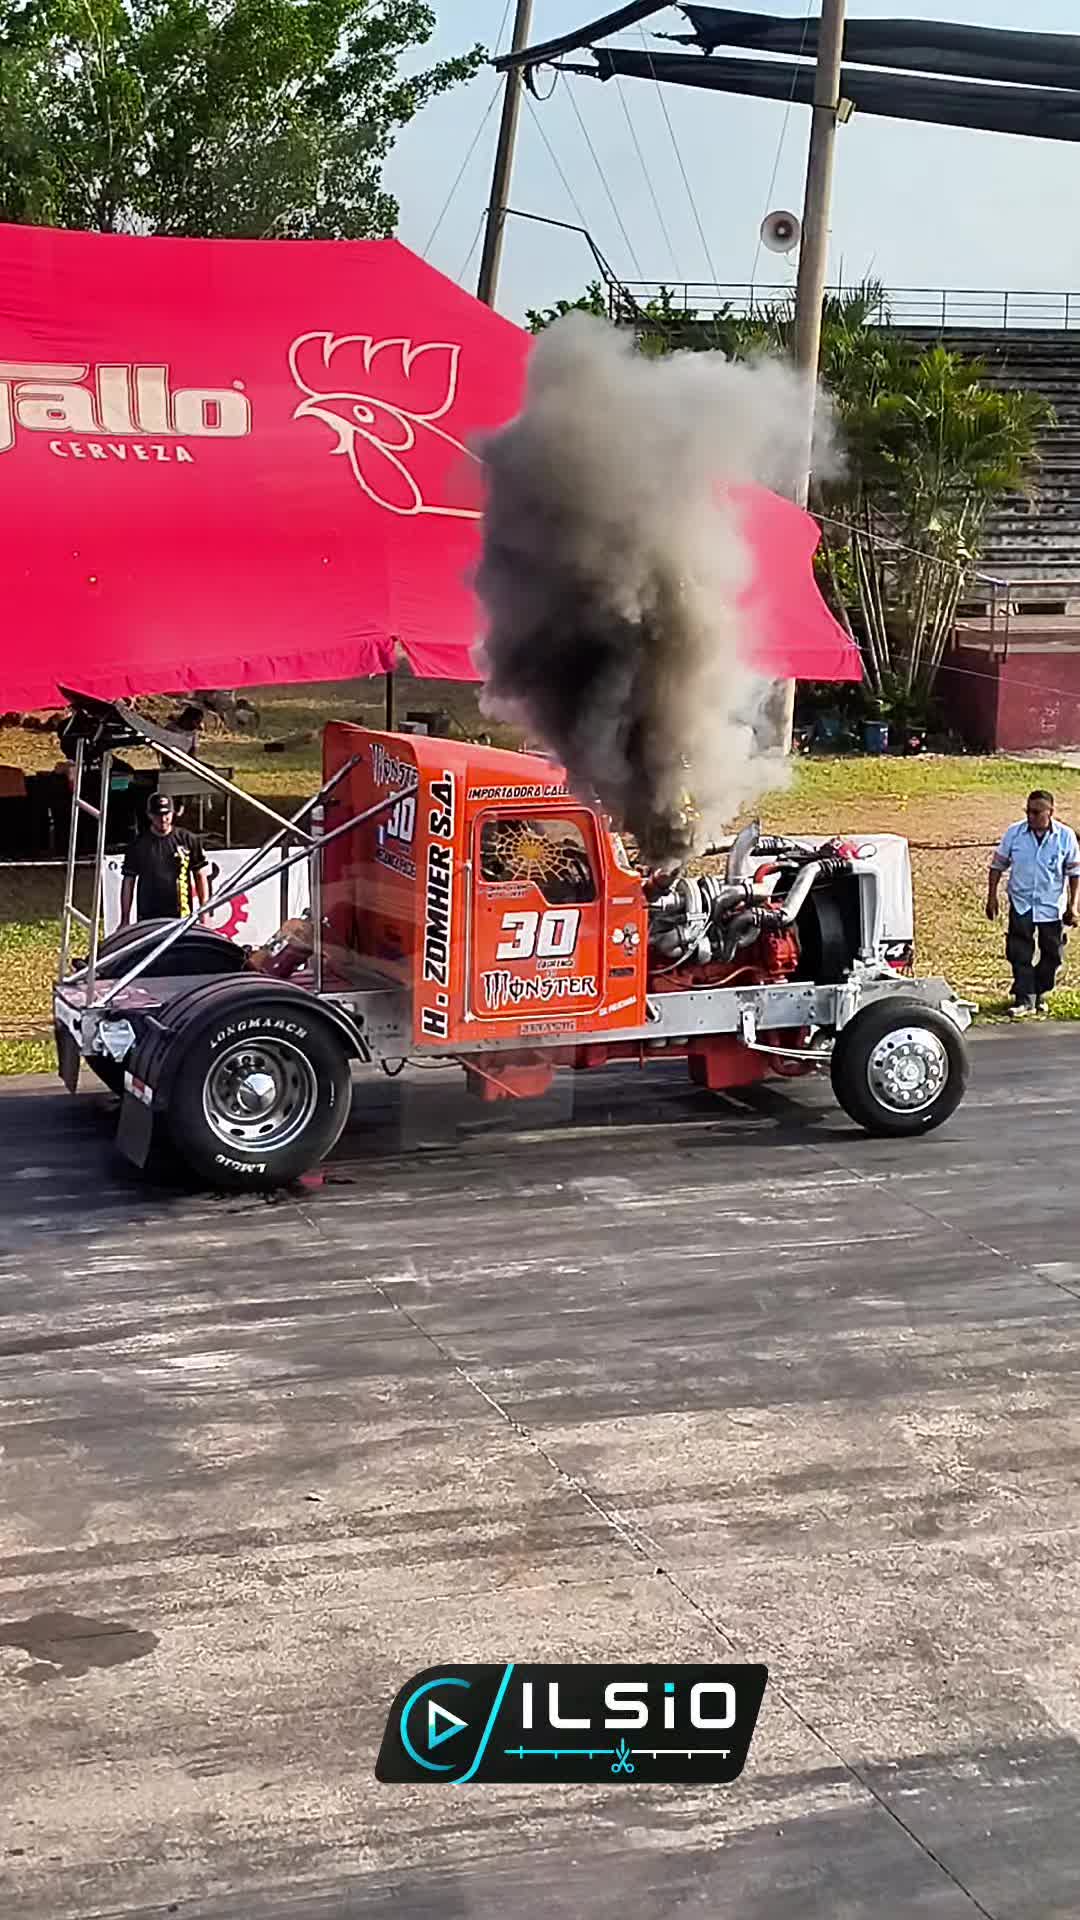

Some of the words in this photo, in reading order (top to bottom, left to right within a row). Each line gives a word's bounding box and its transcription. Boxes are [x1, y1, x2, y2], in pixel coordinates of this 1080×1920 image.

[49, 440, 194, 463] CERVEZA
[468, 784, 541, 800] IMPORTADORA
[388, 790, 416, 842] 30
[424, 842, 453, 987] ZOMHER
[496, 909, 581, 960] 30
[481, 970, 597, 1009] MONSTER
[209, 1017, 308, 1049] LONGMARCH
